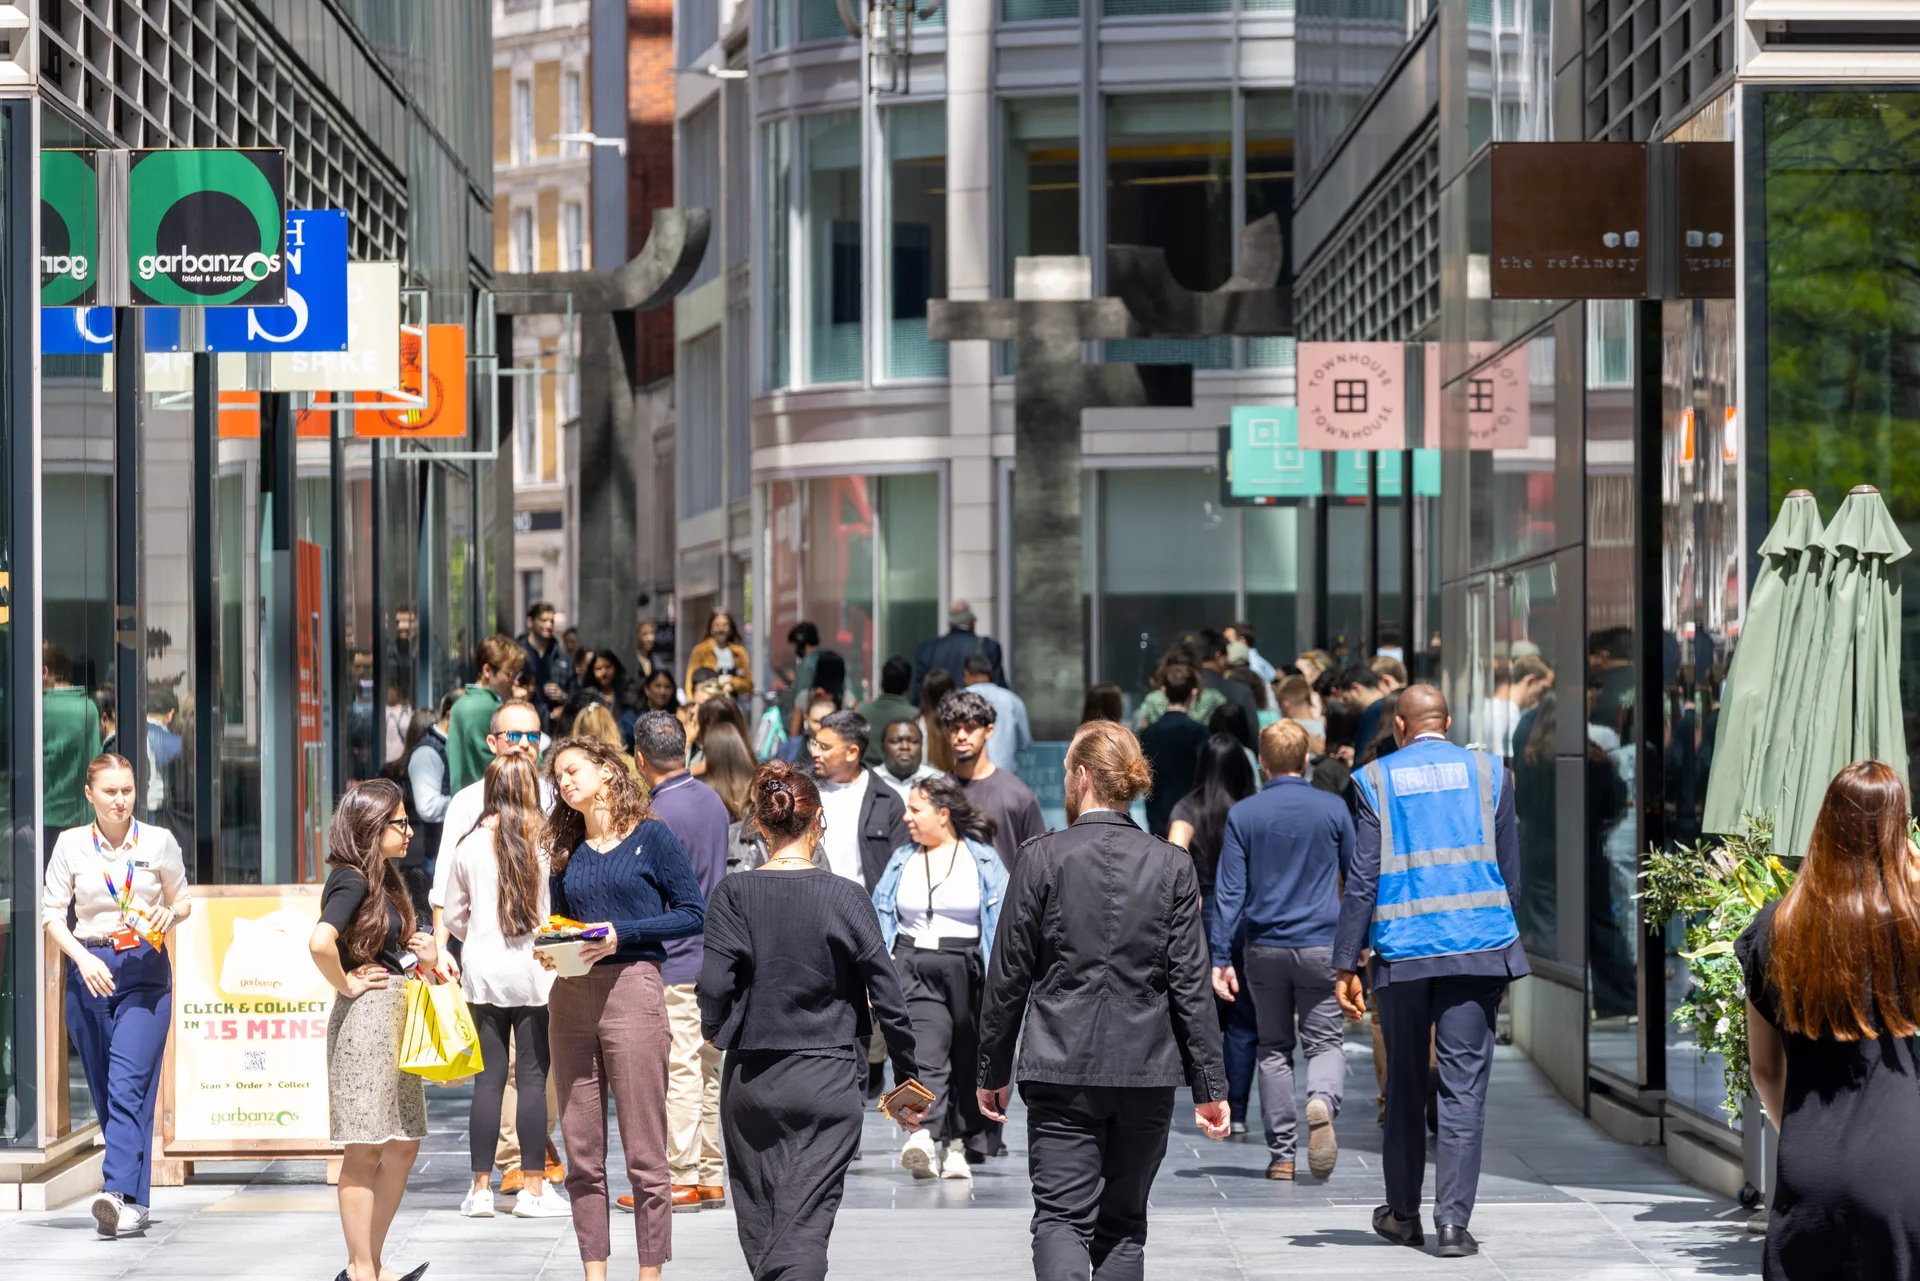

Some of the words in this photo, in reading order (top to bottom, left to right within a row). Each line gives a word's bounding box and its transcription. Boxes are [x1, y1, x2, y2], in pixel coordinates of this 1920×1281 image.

[138, 245, 281, 281] garbanzos
[1500, 257, 1533, 269] the
[1547, 256, 1640, 272] refinery
[181, 274, 203, 282] falafel
[205, 274, 210, 282] &
[212, 274, 231, 282] salad
[232, 274, 244, 282] bar
[291, 351, 379, 373] SPIKE
[1308, 351, 1392, 388] TOWNHOUSE
[1311, 404, 1394, 440] TOWNHOUSE
[1396, 766, 1463, 791] SECURITY
[184, 1003, 234, 1014] CLICK
[239, 1003, 250, 1014] &
[254, 1002, 327, 1014] COLLECT
[184, 1020, 199, 1029] IN
[204, 1020, 238, 1040] 15
[247, 1019, 327, 1040] MINS
[235, 1082, 263, 1090] Order
[278, 1081, 310, 1089] Collect
[211, 1106, 299, 1126] garbanzos
